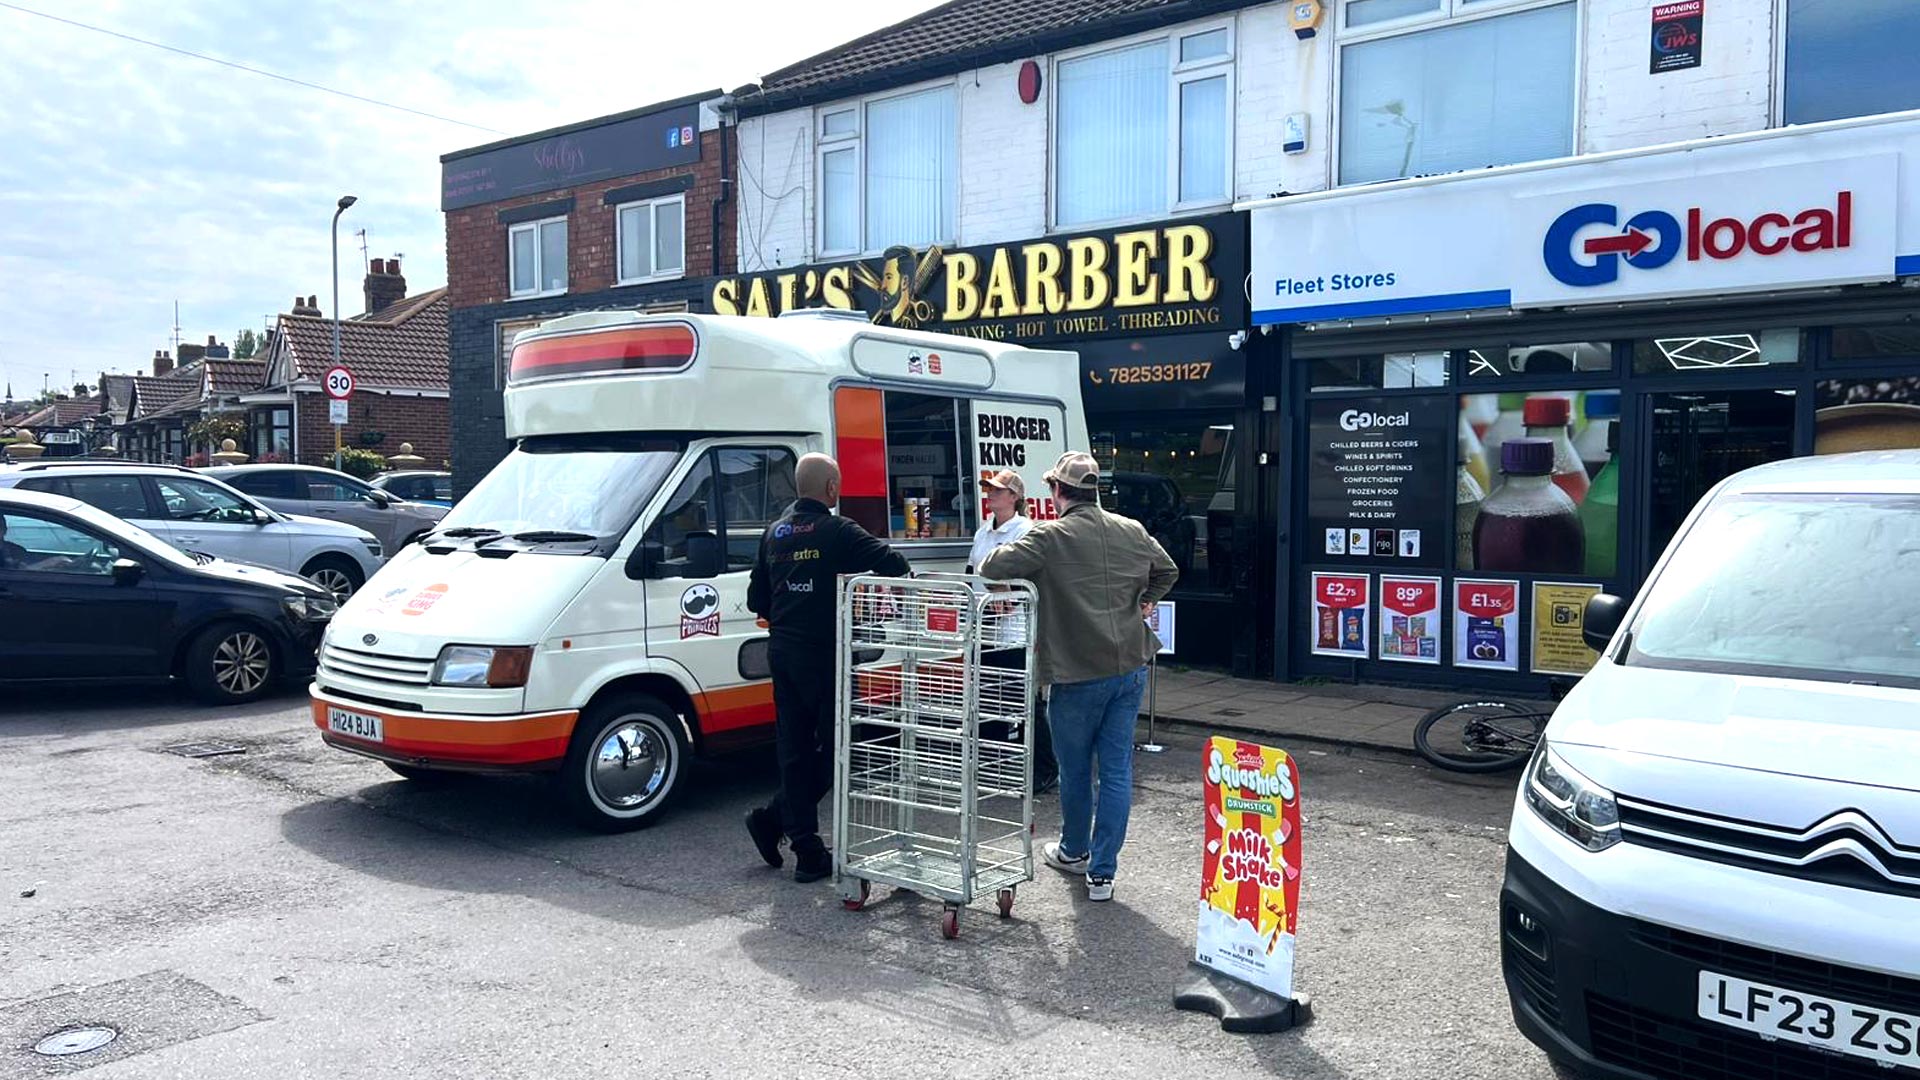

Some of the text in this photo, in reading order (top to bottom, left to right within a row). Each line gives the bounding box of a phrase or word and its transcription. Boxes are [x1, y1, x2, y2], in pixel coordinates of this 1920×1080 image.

[1655, 2, 1700, 16] WARNING
[942, 225, 1215, 322] BARBER
[1275, 270, 1395, 296] Fleet Stores
[1016, 321, 1046, 338] HOT
[1054, 317, 1108, 334] TOWEL
[1119, 307, 1220, 330] THREADING
[330, 375, 350, 390] 30
[1109, 362, 1212, 384] 7825331127
[978, 413, 1051, 441] BURGER
[979, 442, 1026, 467] KING
[1392, 440, 1419, 448] CIDERS
[1344, 476, 1404, 484] CONFECTIONERY
[794, 549, 819, 560] extra
[786, 578, 813, 592] local
[1471, 593, 1502, 608] £1.35
[682, 615, 718, 638] PRINGLES
[356, 715, 377, 738] BJA
[1227, 799, 1272, 813] DRUMSTICK
[1228, 831, 1271, 862] Milk
[1223, 856, 1281, 888] Shake
[1718, 980, 1920, 1057] LF23 ZS
